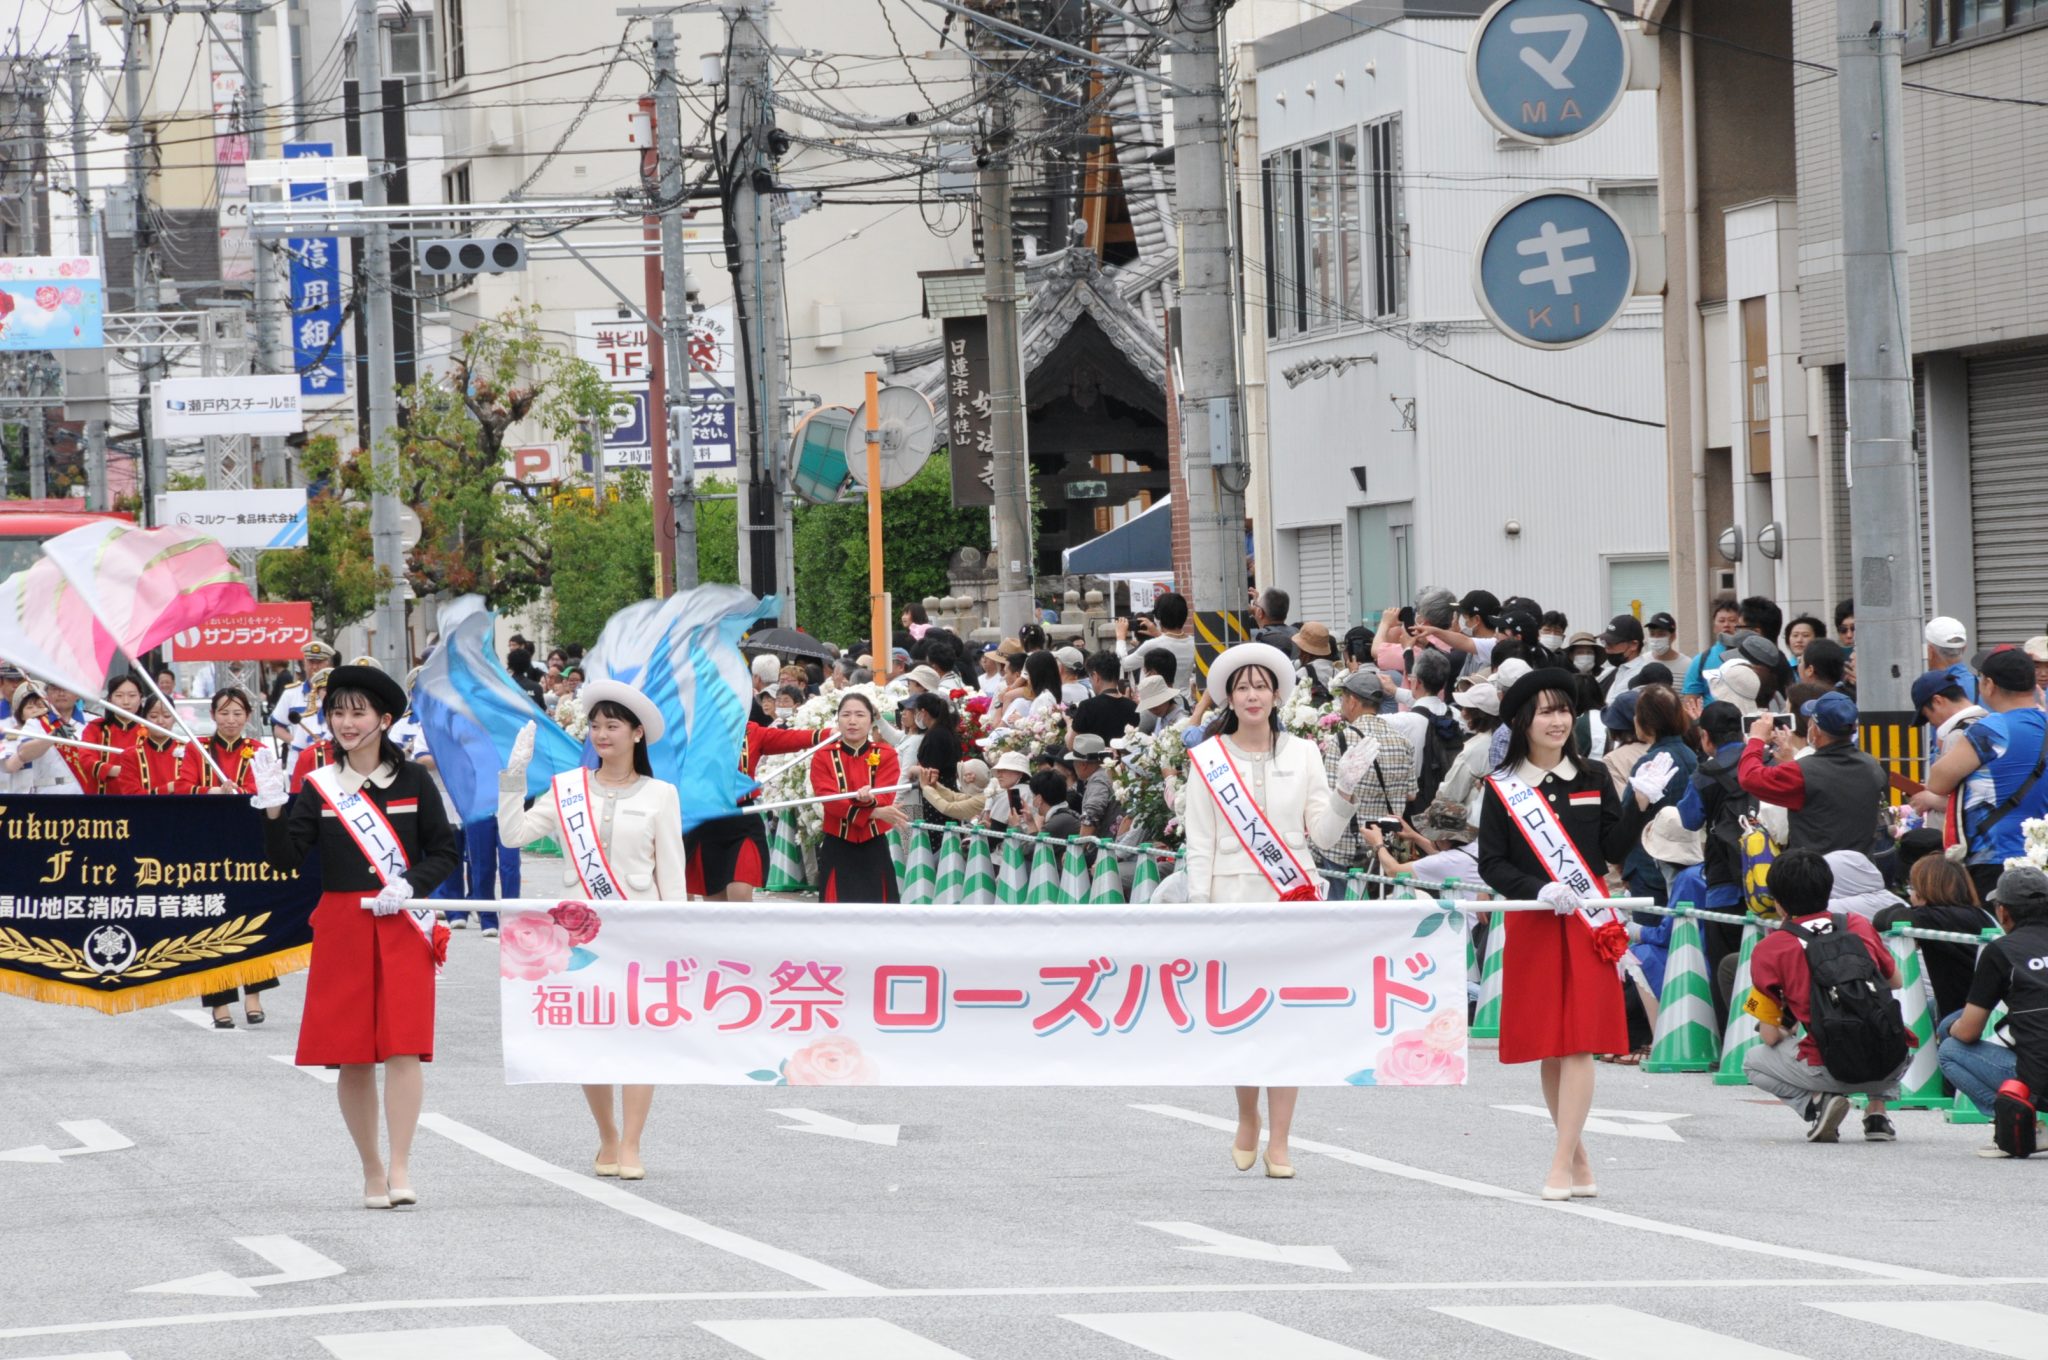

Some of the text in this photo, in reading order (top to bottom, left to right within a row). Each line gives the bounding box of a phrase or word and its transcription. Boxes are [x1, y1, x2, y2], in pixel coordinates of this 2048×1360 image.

[1510, 13, 1588, 89] マ
[1522, 98, 1582, 123] MA
[1516, 221, 1596, 295] キ
[1528, 304, 1581, 329] KI
[606, 352, 642, 376] 1F
[953, 402, 972, 446] 本性山
[195, 513, 298, 525] マルケー食品株式会社
[203, 627, 309, 645] サンラヴィアン
[1206, 763, 1230, 782] 2025
[337, 794, 361, 811] 2024
[561, 793, 584, 808] 2025
[1508, 788, 1534, 806] 2024
[1219, 783, 1297, 886] ローズ福山
[40, 850, 117, 886] Fire
[531, 951, 1436, 1037] 福山ばら祭 ローズパレード
